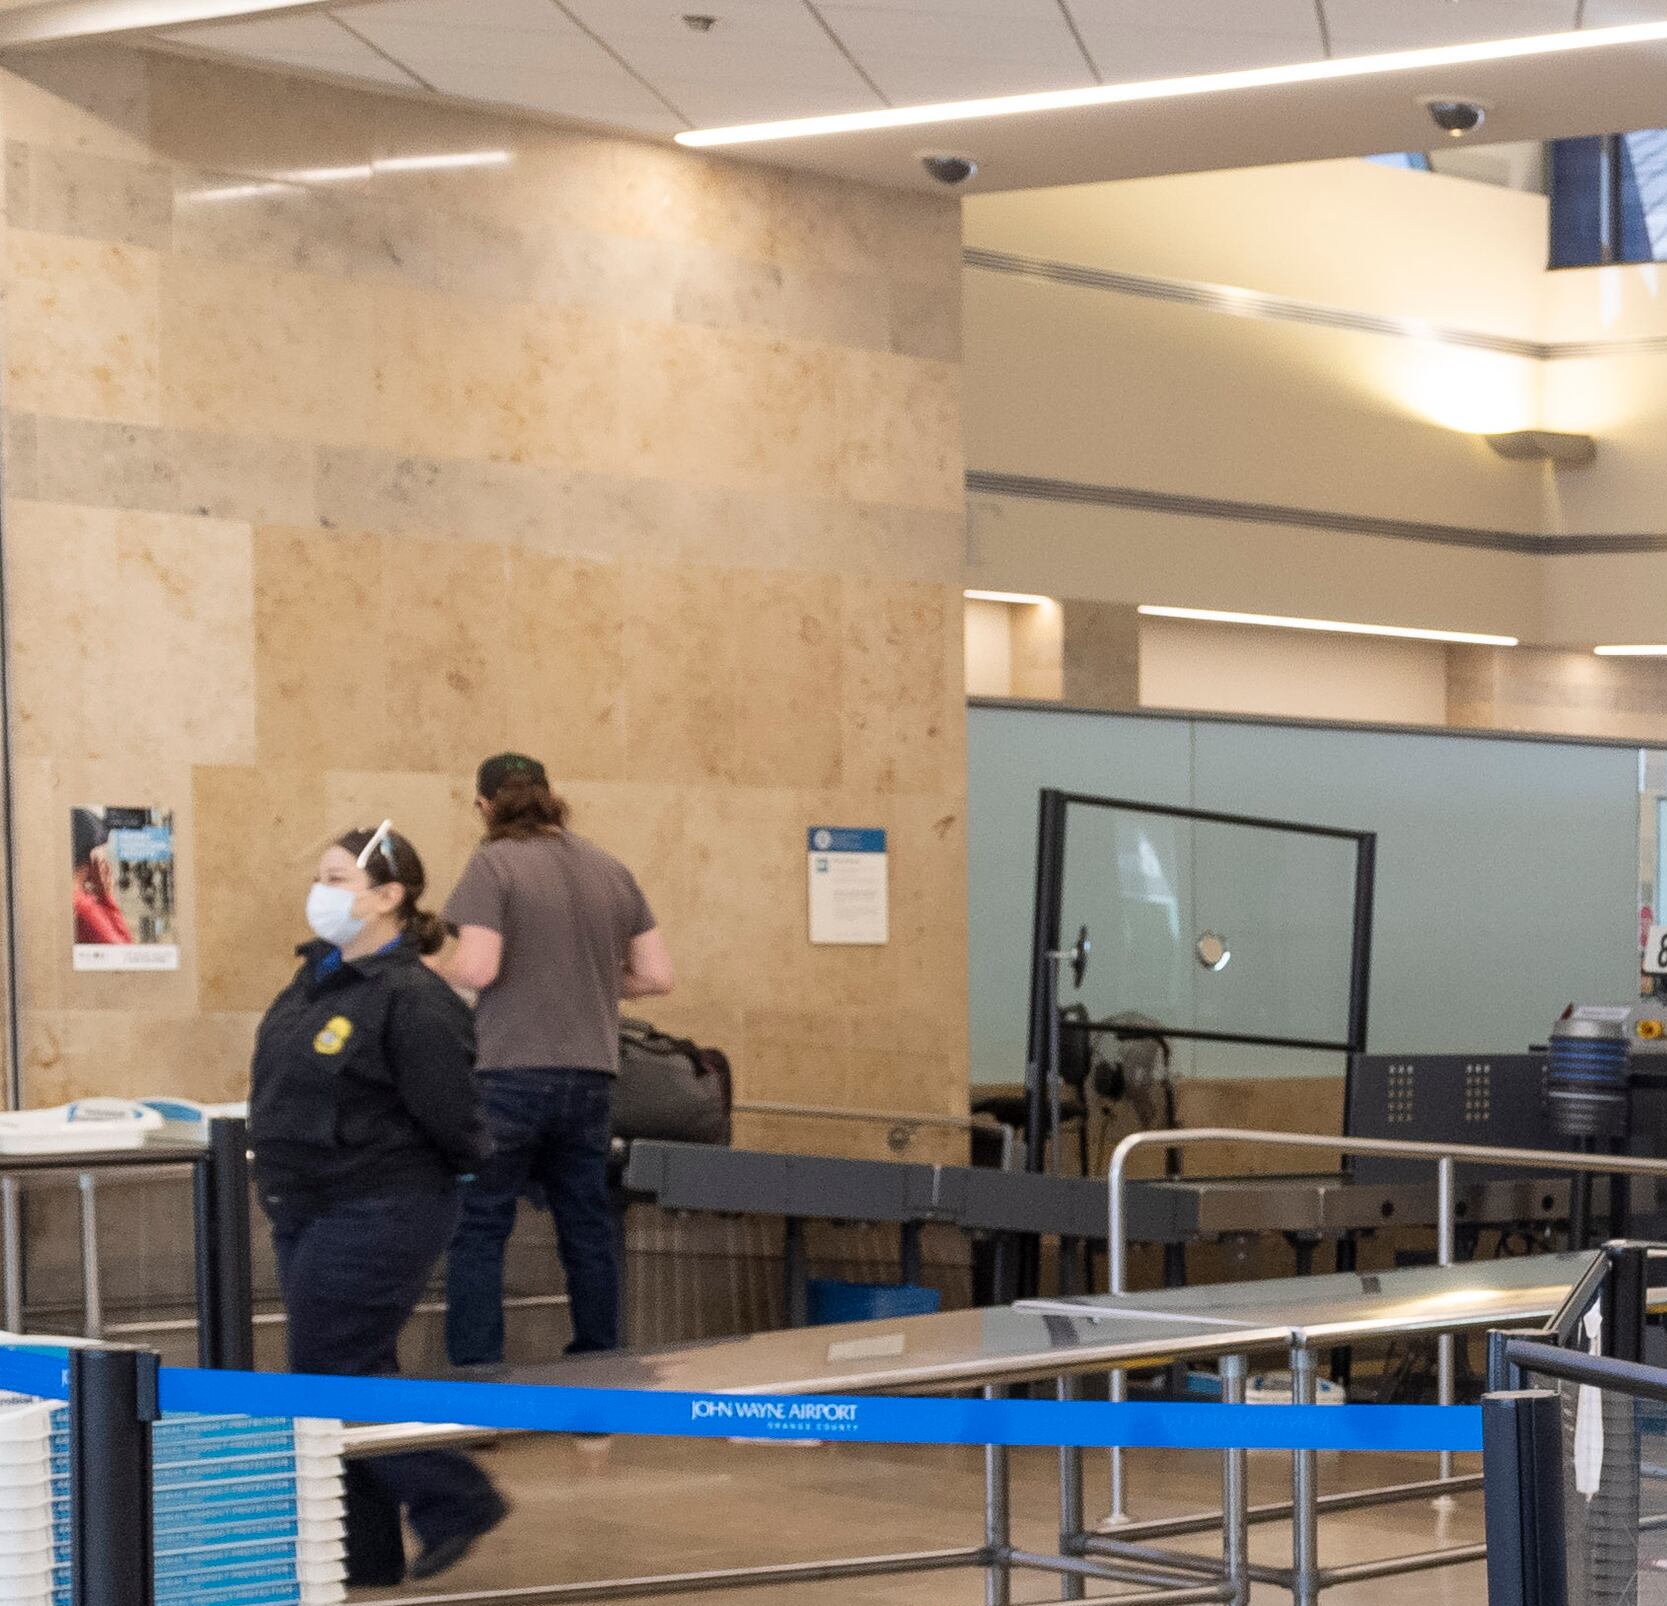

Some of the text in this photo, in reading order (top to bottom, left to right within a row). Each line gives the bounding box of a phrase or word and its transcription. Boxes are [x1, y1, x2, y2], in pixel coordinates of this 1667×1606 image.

[692, 1400, 858, 1421] JOHN WAYNE AIRPORT
